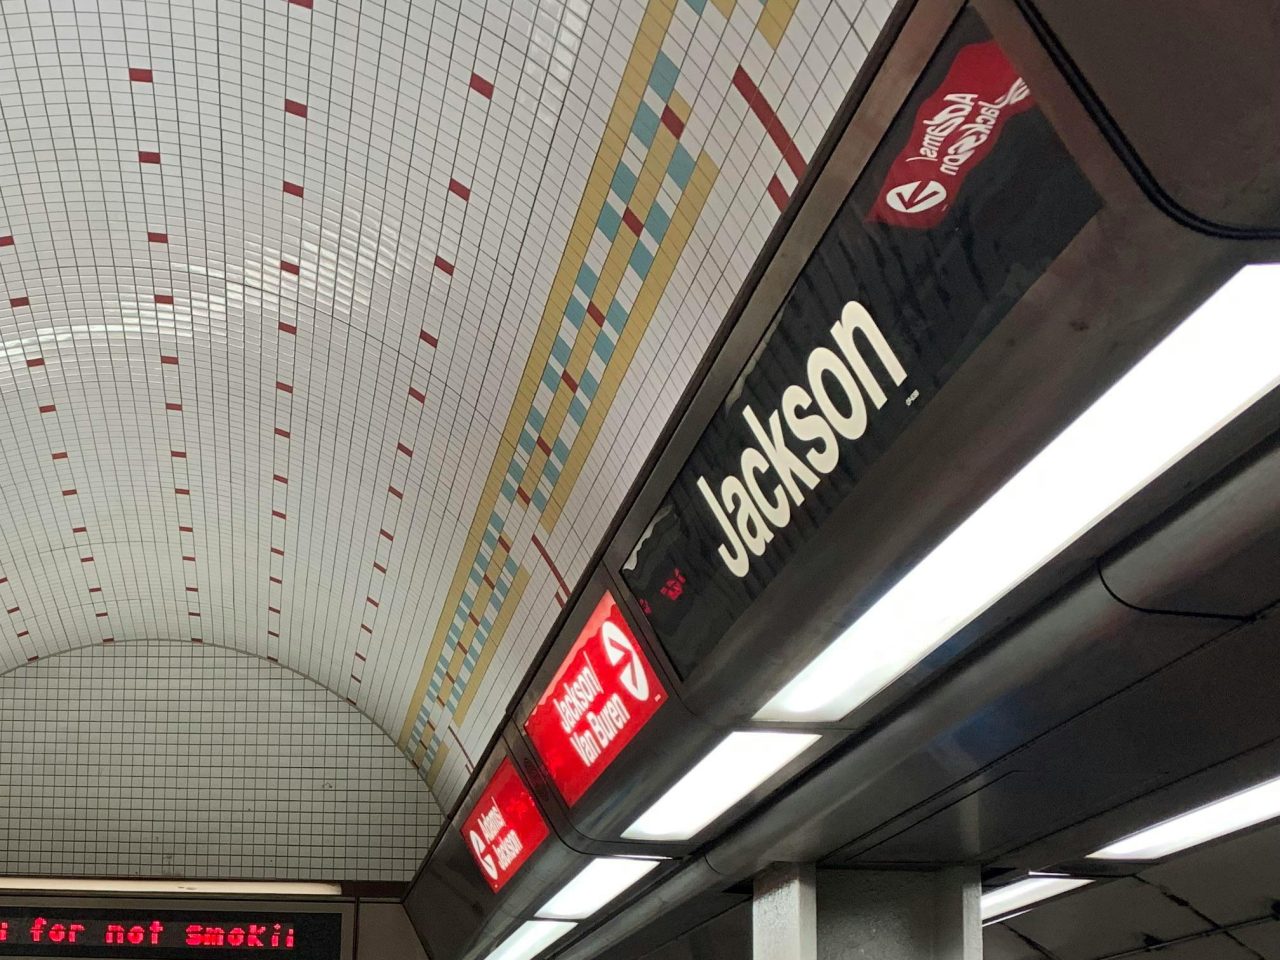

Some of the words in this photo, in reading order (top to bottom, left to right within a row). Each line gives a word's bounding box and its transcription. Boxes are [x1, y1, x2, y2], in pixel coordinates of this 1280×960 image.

[696, 300, 907, 578] Jackson
[553, 651, 604, 734] Jackson/
[570, 728, 602, 767] Van
[587, 693, 631, 749] Buren
[491, 829, 523, 871] Jackson
[30, 917, 85, 944] for
[106, 921, 164, 944] not
